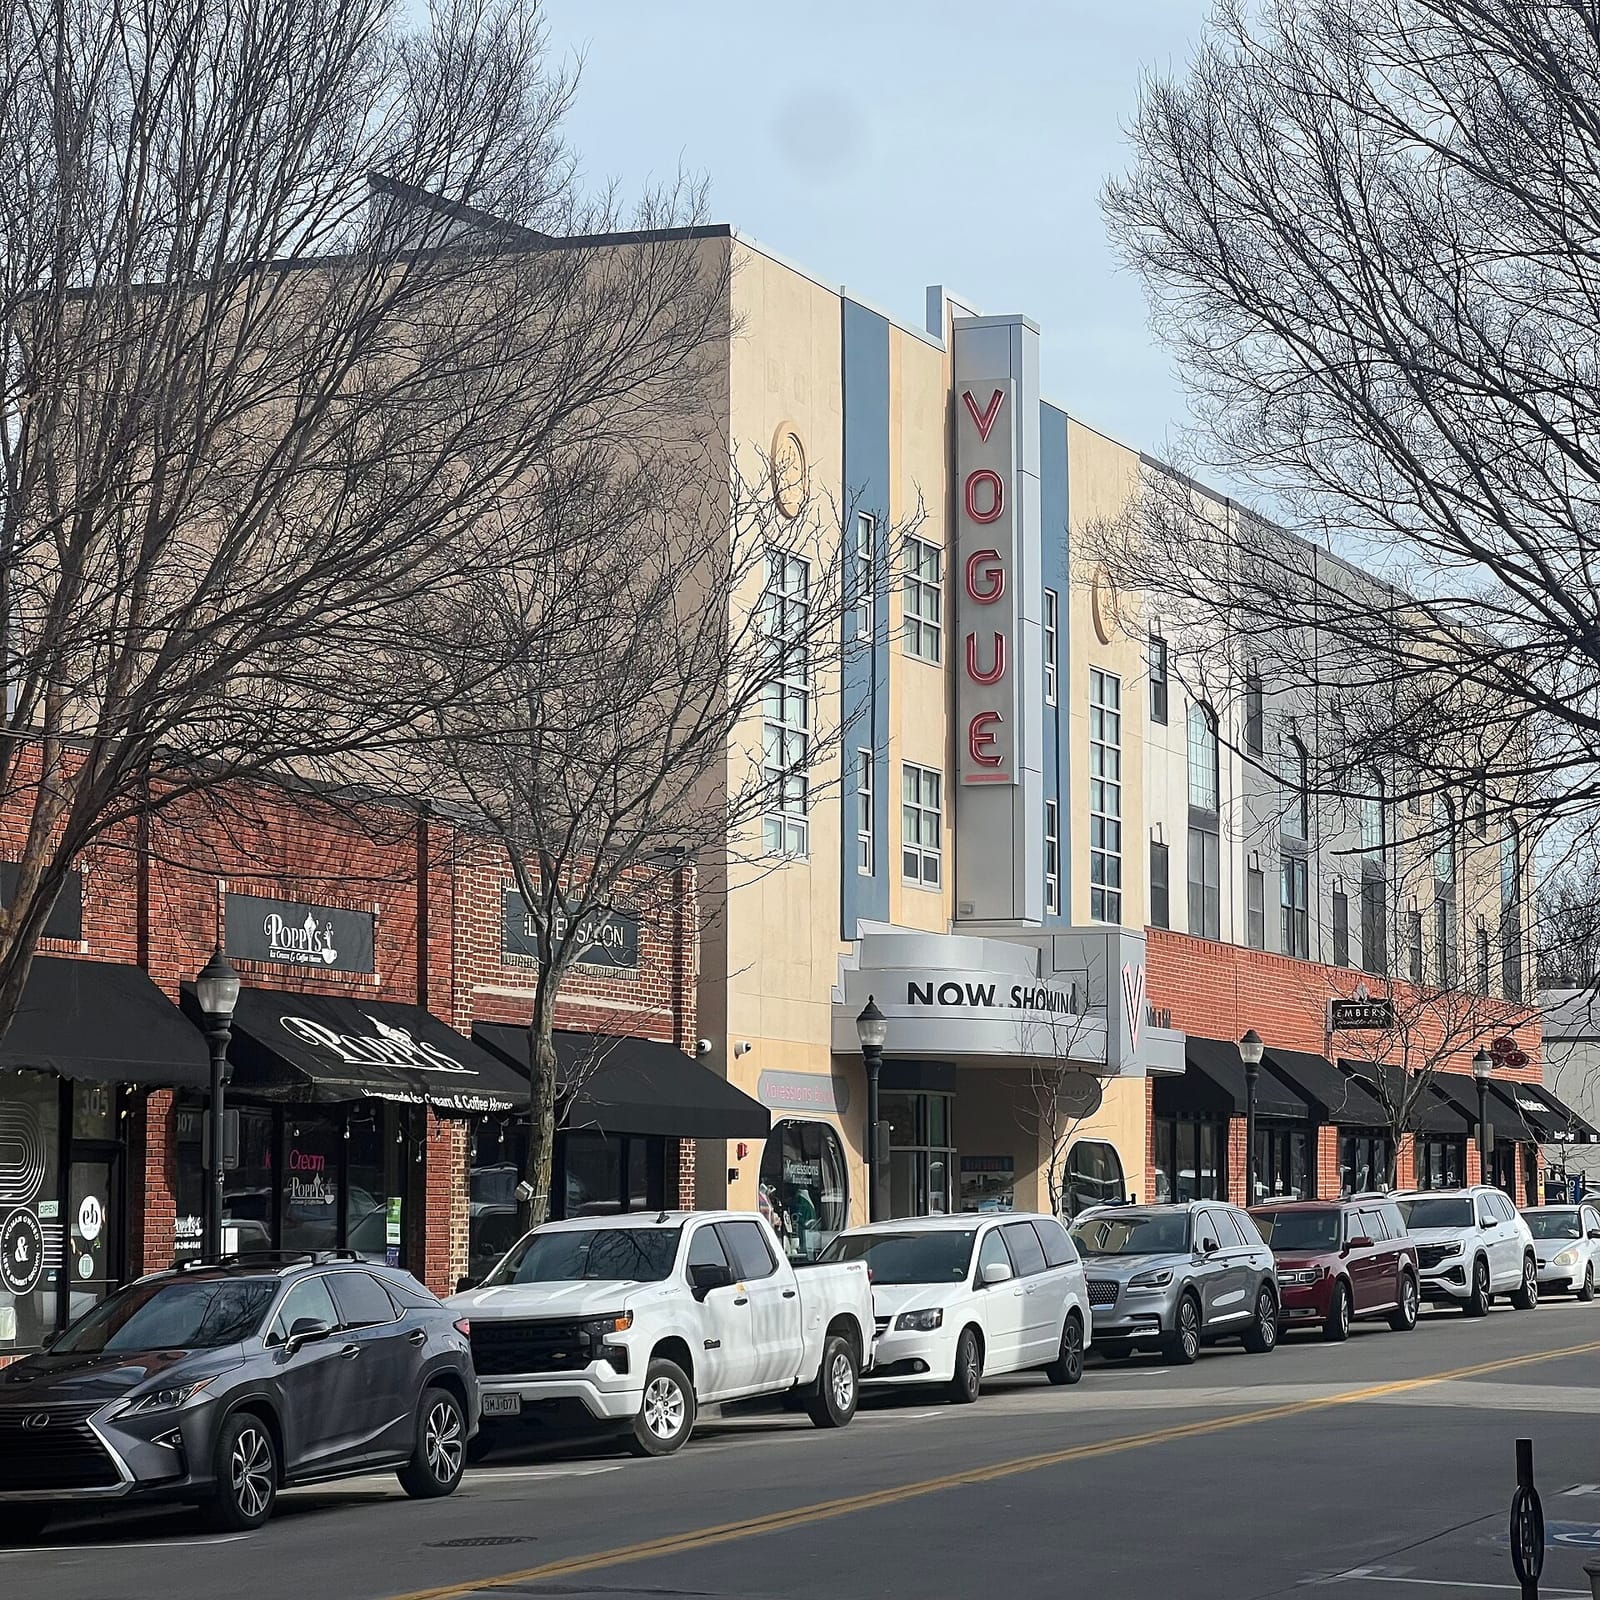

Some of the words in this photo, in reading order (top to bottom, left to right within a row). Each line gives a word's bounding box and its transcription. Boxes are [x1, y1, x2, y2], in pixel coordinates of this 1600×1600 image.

[962, 388, 1006, 768] VOGUE
[264, 913, 322, 952] POPPY'S
[907, 981, 996, 1007] NOW
[1336, 1008, 1386, 1018] EMBERS
[424, 1093, 455, 1108] Cream
[454, 1094, 464, 1109] &
[462, 1095, 489, 1111] Coffee
[289, 1149, 325, 1171] Cream
[40, 1204, 57, 1214] OPEN
[4, 1215, 23, 1240] WOMAN
[23, 1215, 39, 1240] OWNED
[14, 1236, 29, 1263] &
[28, 1252, 40, 1282] GROWN
